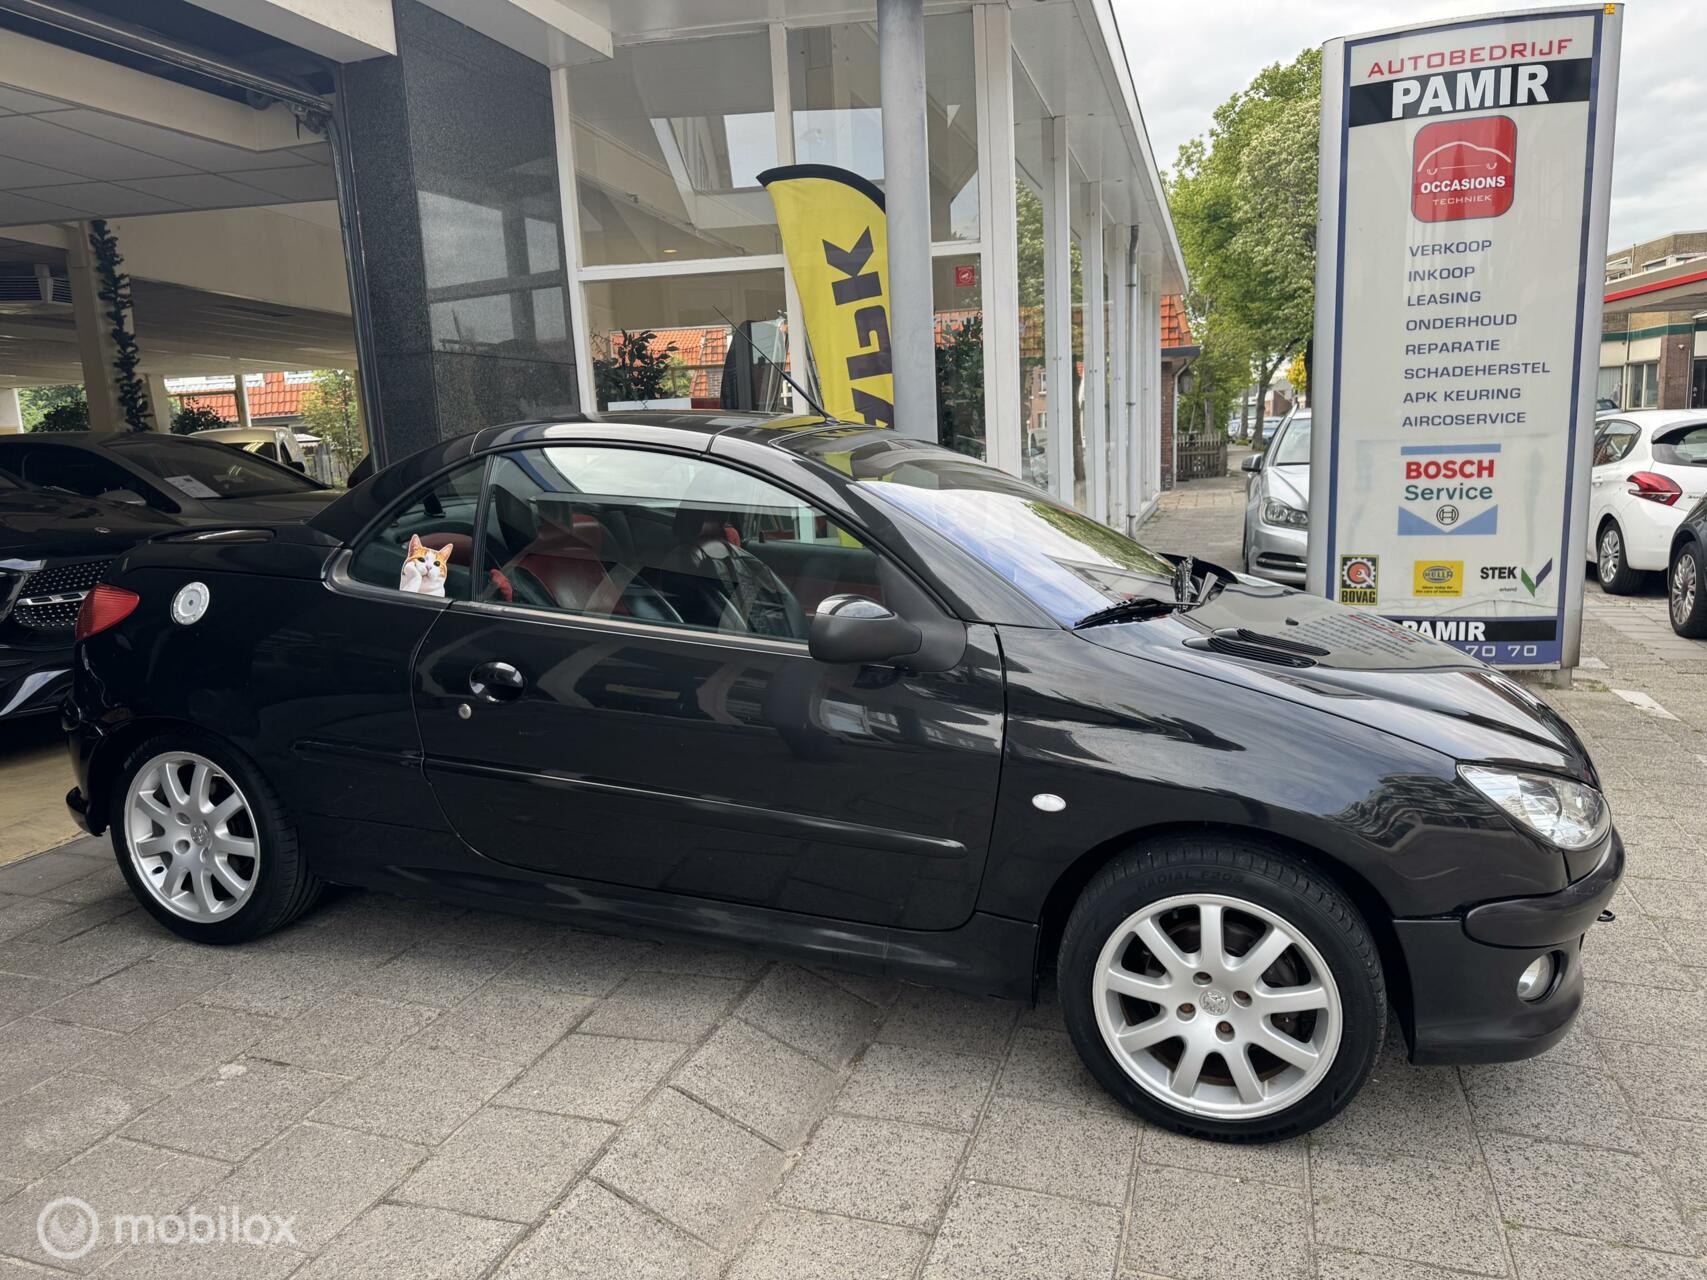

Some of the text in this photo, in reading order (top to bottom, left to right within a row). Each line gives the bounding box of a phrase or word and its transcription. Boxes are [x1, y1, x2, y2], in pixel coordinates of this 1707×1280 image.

[1367, 38, 1574, 78] AUTOBEDRIJF
[1391, 64, 1549, 119] PAMIR
[1420, 175, 1506, 194] OCCASIONS
[1432, 194, 1492, 206] TECHNIEK
[1409, 239, 1493, 258] VERKOOP
[1408, 266, 1476, 283] INKOOP
[1407, 290, 1482, 307] LEASING
[1406, 313, 1518, 332] ONDERHOUD
[1405, 339, 1500, 356] REPARATIE
[1403, 361, 1551, 380] SCHADEHERSTEL
[1402, 387, 1522, 404] APK KEURING
[1401, 411, 1527, 428] AIRCOSERVICE
[1405, 459, 1495, 480] BOSCH
[1404, 482, 1493, 502] Service
[1480, 566, 1517, 580] STEK
[1341, 590, 1376, 604] BOVAG
[1508, 644, 1538, 657] 70
